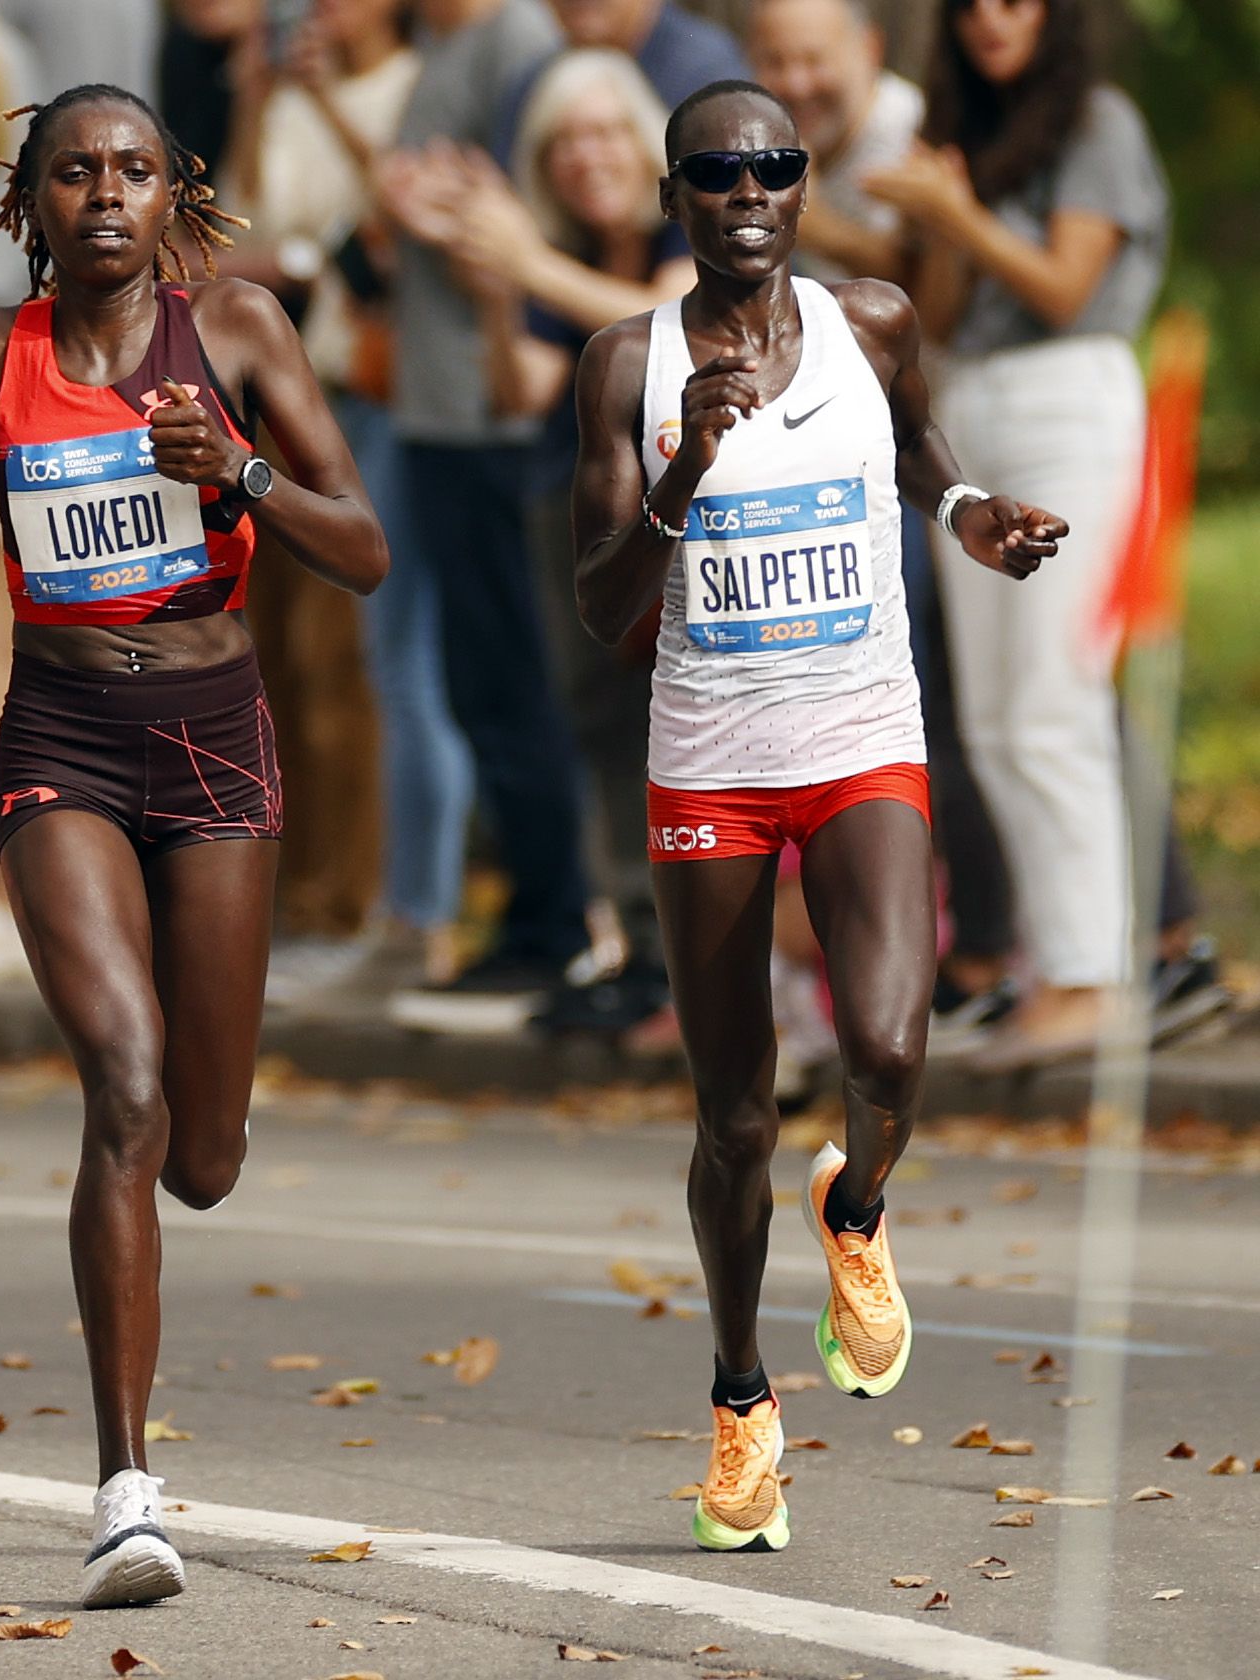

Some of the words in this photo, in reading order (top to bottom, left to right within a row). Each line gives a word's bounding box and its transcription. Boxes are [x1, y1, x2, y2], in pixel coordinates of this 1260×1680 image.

[63, 448, 89, 460] TATA
[63, 452, 123, 469] CONSULTANCY
[137, 456, 155, 467] TA
[21, 456, 62, 482] tcs
[65, 465, 104, 479] SERVICES
[742, 500, 768, 511] TATA
[743, 504, 801, 520] CONSULTANCY
[814, 505, 848, 520] TATA
[47, 490, 168, 562] LOKEDI
[699, 506, 740, 532] tcs
[744, 516, 782, 529] SERVICES
[89, 565, 149, 591] 2022
[700, 542, 861, 613] SALPETER
[759, 619, 819, 643] 2022
[650, 824, 717, 851] NEOS
